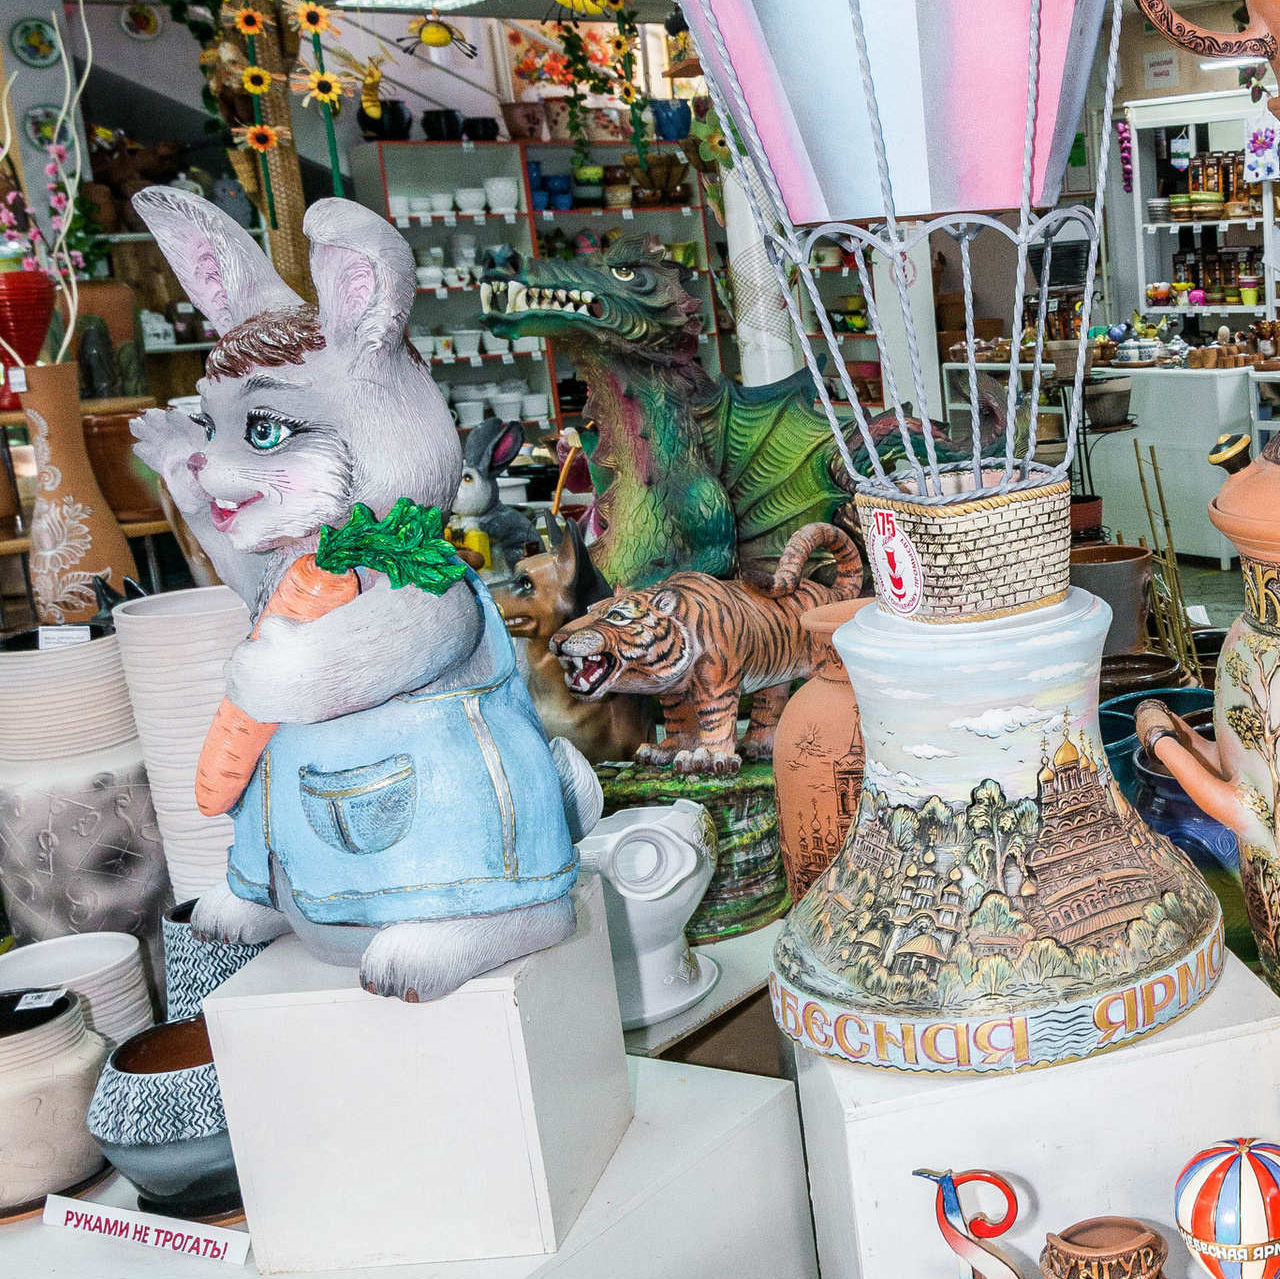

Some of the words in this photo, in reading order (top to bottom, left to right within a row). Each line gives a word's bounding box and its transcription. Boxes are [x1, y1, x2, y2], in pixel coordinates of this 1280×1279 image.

[873, 511, 896, 538] 175
[1094, 916, 1225, 1045] ЯРМА
[64, 1209, 130, 1239] РУКАМИ
[132, 1224, 151, 1244] НЕ
[154, 1228, 229, 1261] ТРОГАТЬ!
